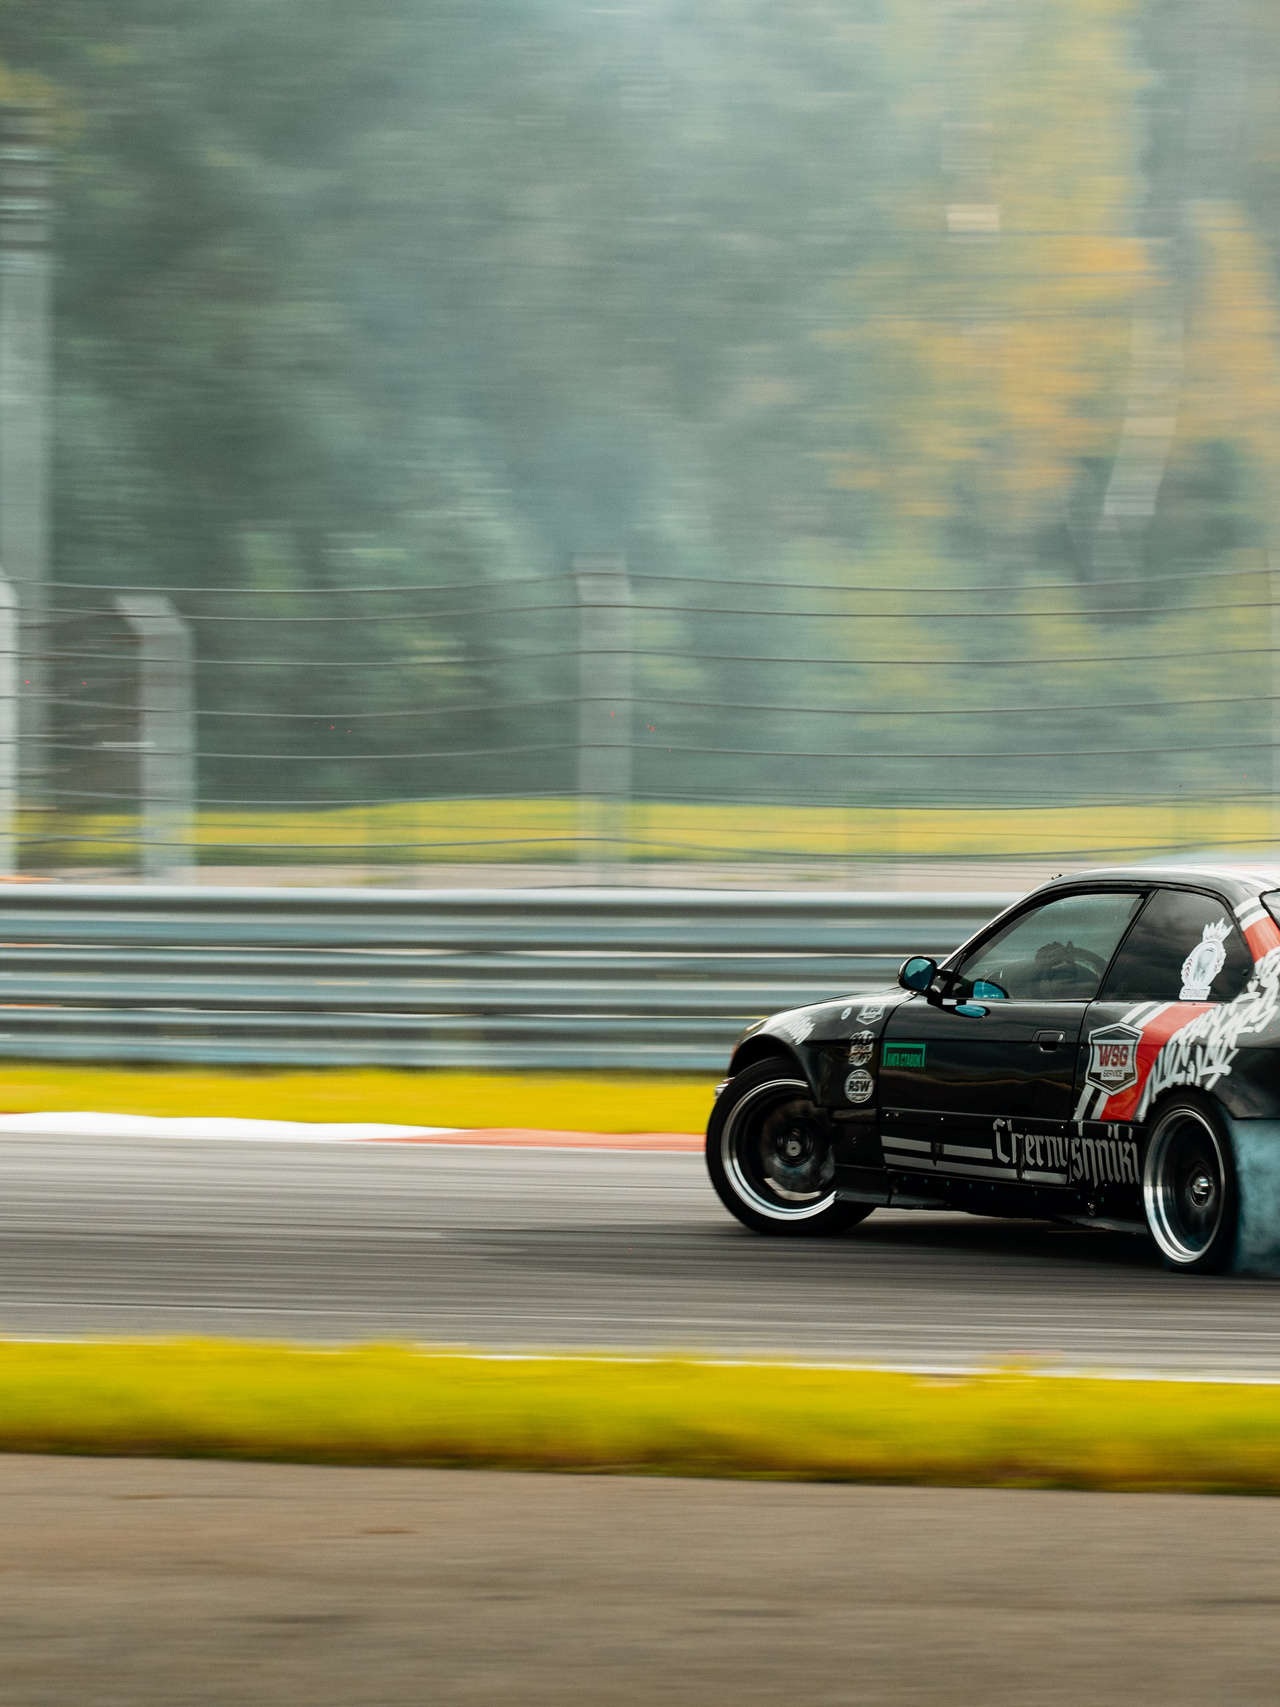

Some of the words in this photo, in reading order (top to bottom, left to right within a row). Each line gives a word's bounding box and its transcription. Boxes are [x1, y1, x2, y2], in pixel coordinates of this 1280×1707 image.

[1097, 1044, 1129, 1067] WSG
[1102, 1069, 1123, 1078] SERVICE
[848, 1080, 871, 1092] RSW
